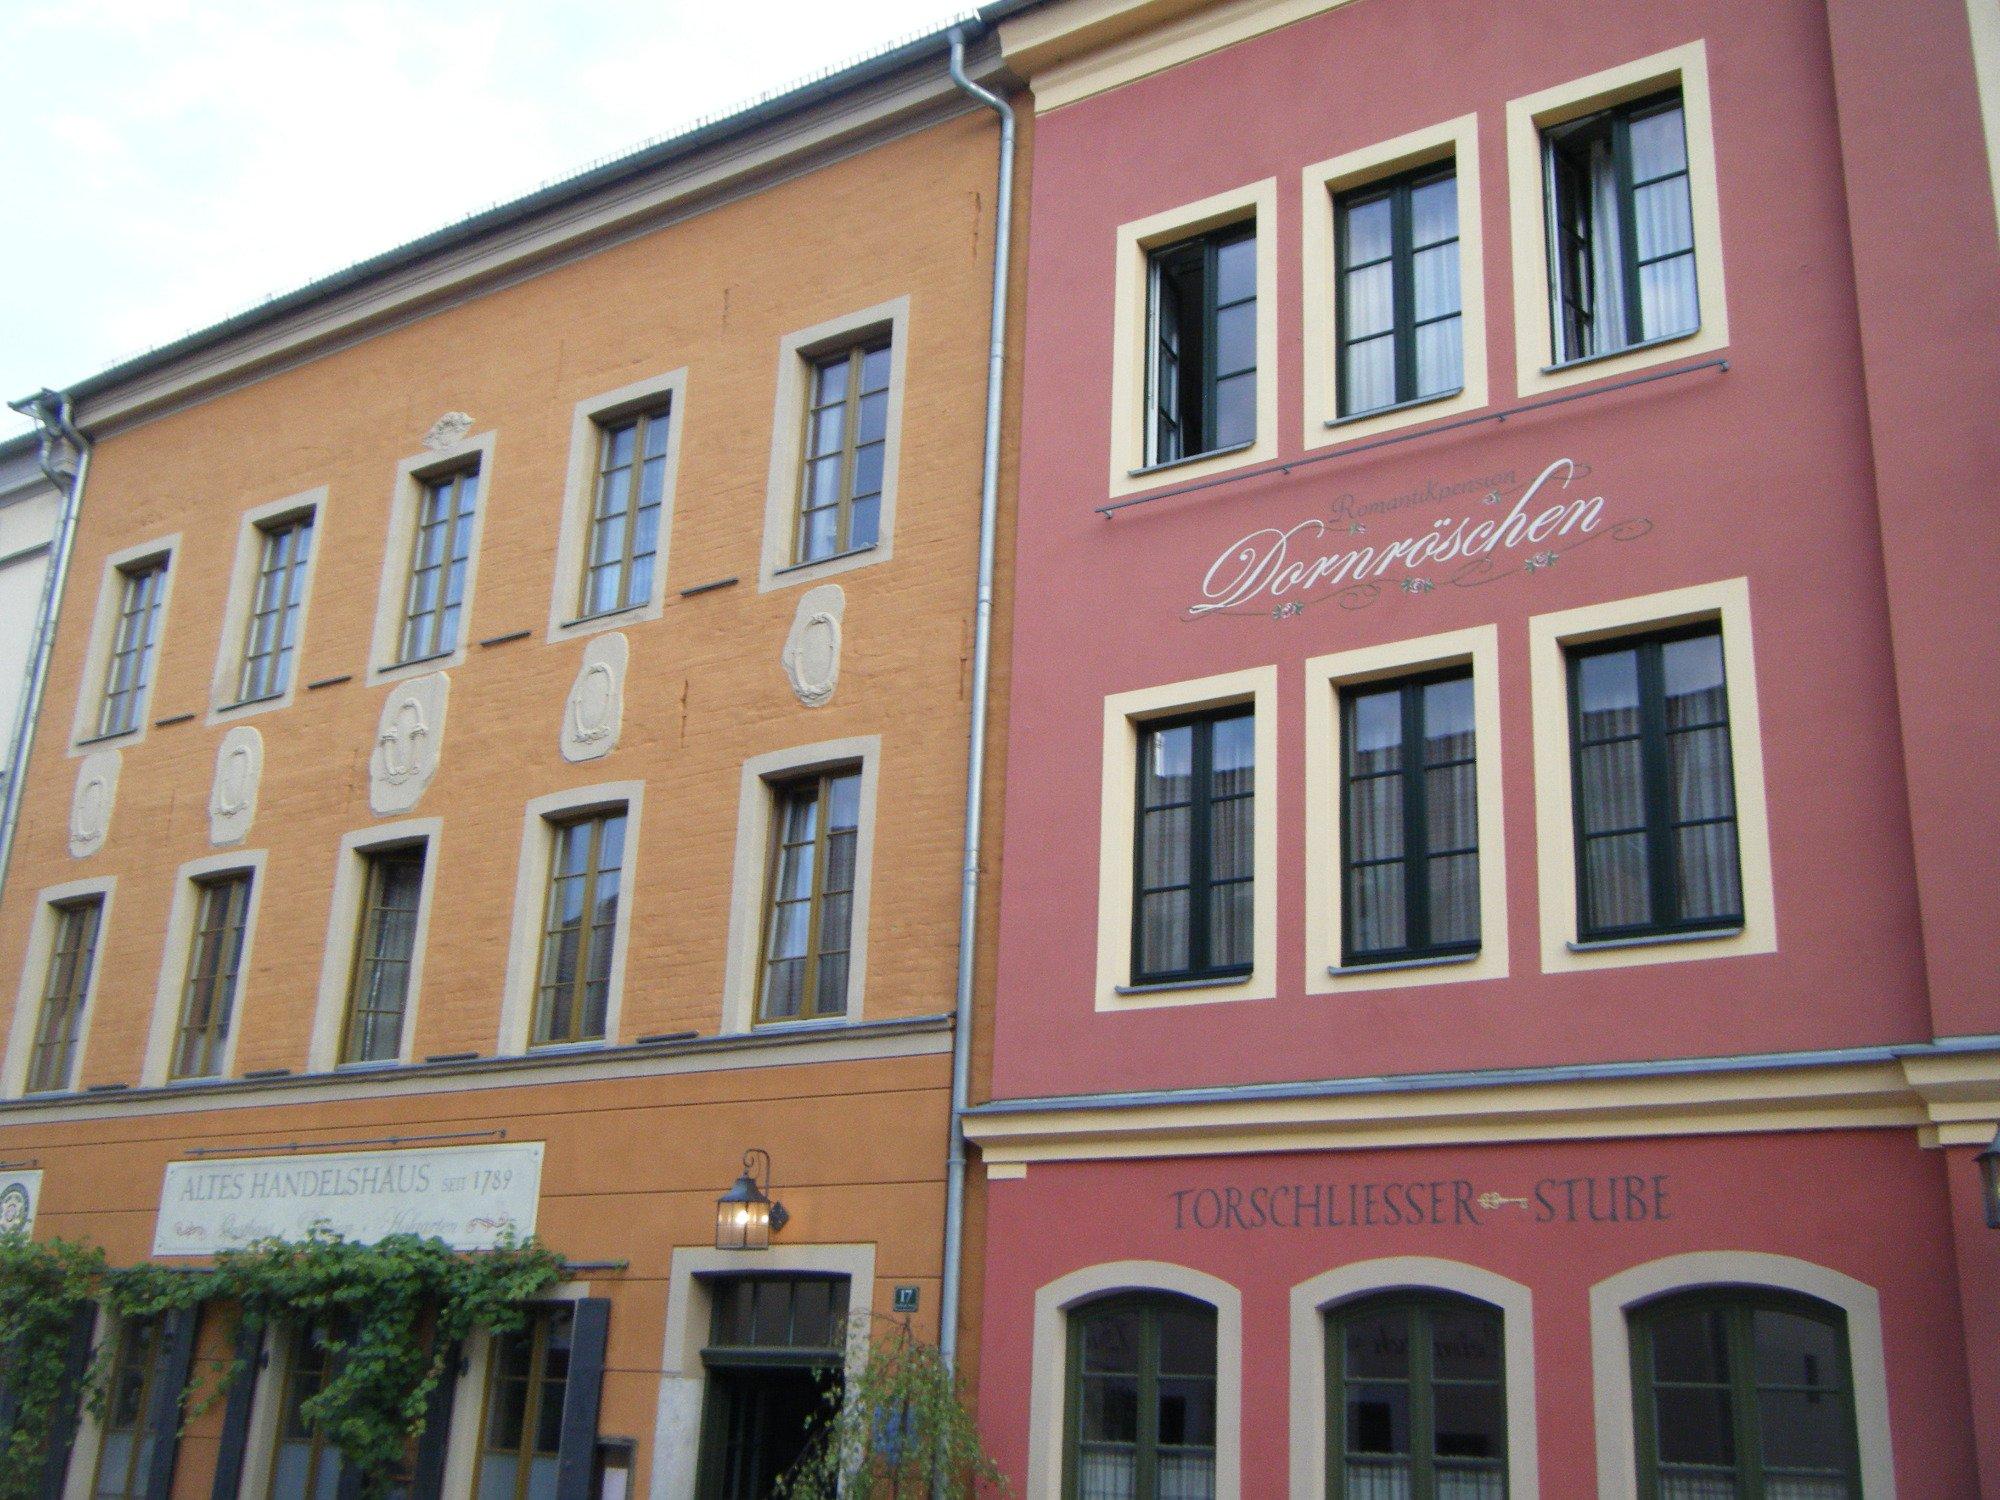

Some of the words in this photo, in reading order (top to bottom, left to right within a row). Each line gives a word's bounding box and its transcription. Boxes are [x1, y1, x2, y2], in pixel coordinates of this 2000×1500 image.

[1329, 470, 1517, 522] Romantikpension
[1189, 458, 1604, 614] Dornröschen
[178, 1171, 246, 1202] ALTES
[249, 1163, 432, 1199] HANDELSHAUS
[473, 1169, 513, 1196] 1789
[1170, 1179, 1484, 1231] TORSCHLIESSER
[1532, 1174, 1674, 1224] STUBE
[899, 1289, 913, 1303] 17
